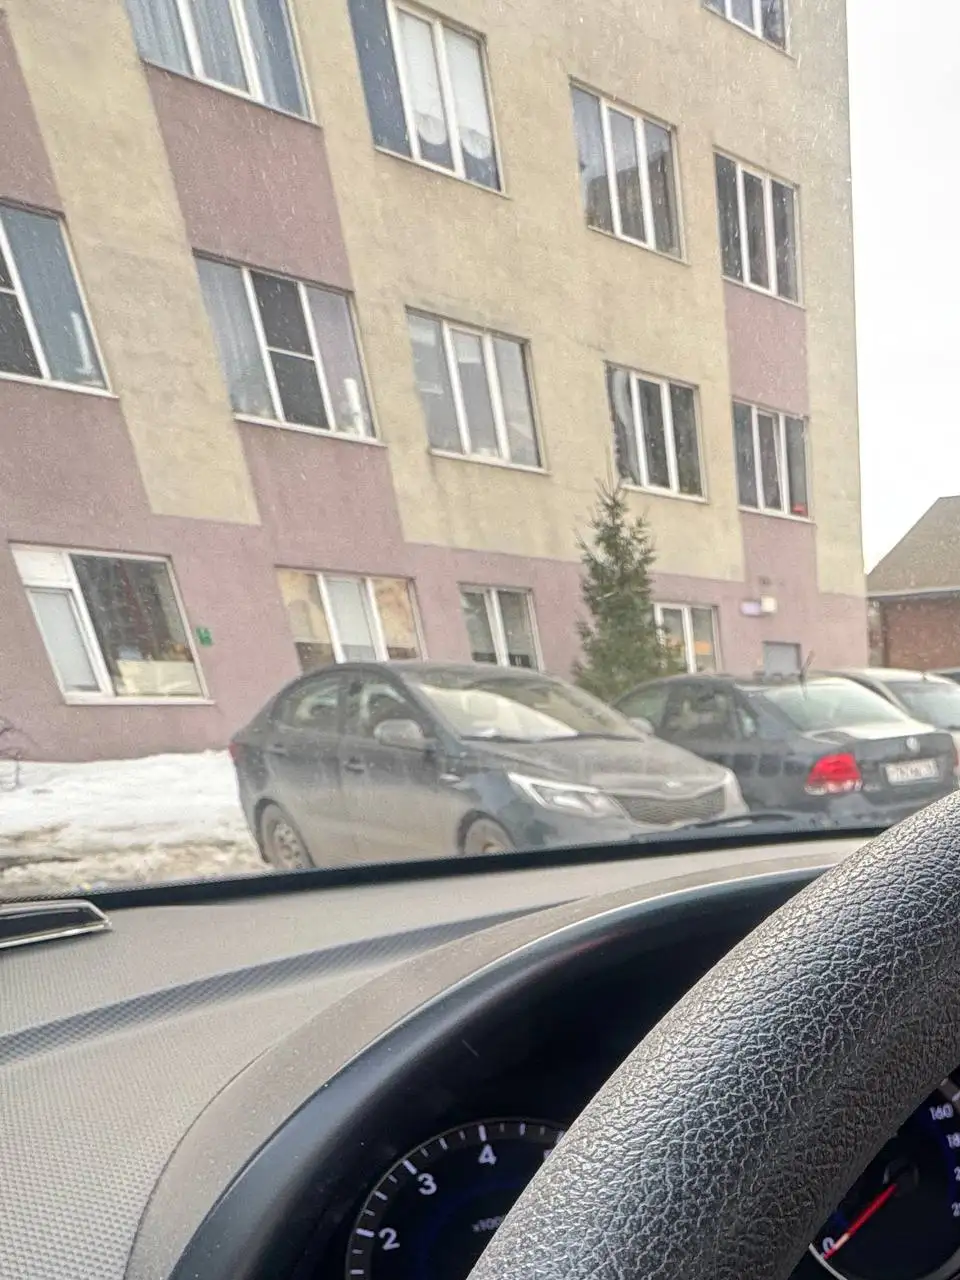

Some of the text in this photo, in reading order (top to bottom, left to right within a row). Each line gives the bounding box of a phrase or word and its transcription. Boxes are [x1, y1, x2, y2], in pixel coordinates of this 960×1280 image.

[930, 1104, 954, 1120] 160
[478, 1144, 497, 1166] 4
[416, 1173, 437, 1196] 3
[378, 1227, 401, 1250] 2
